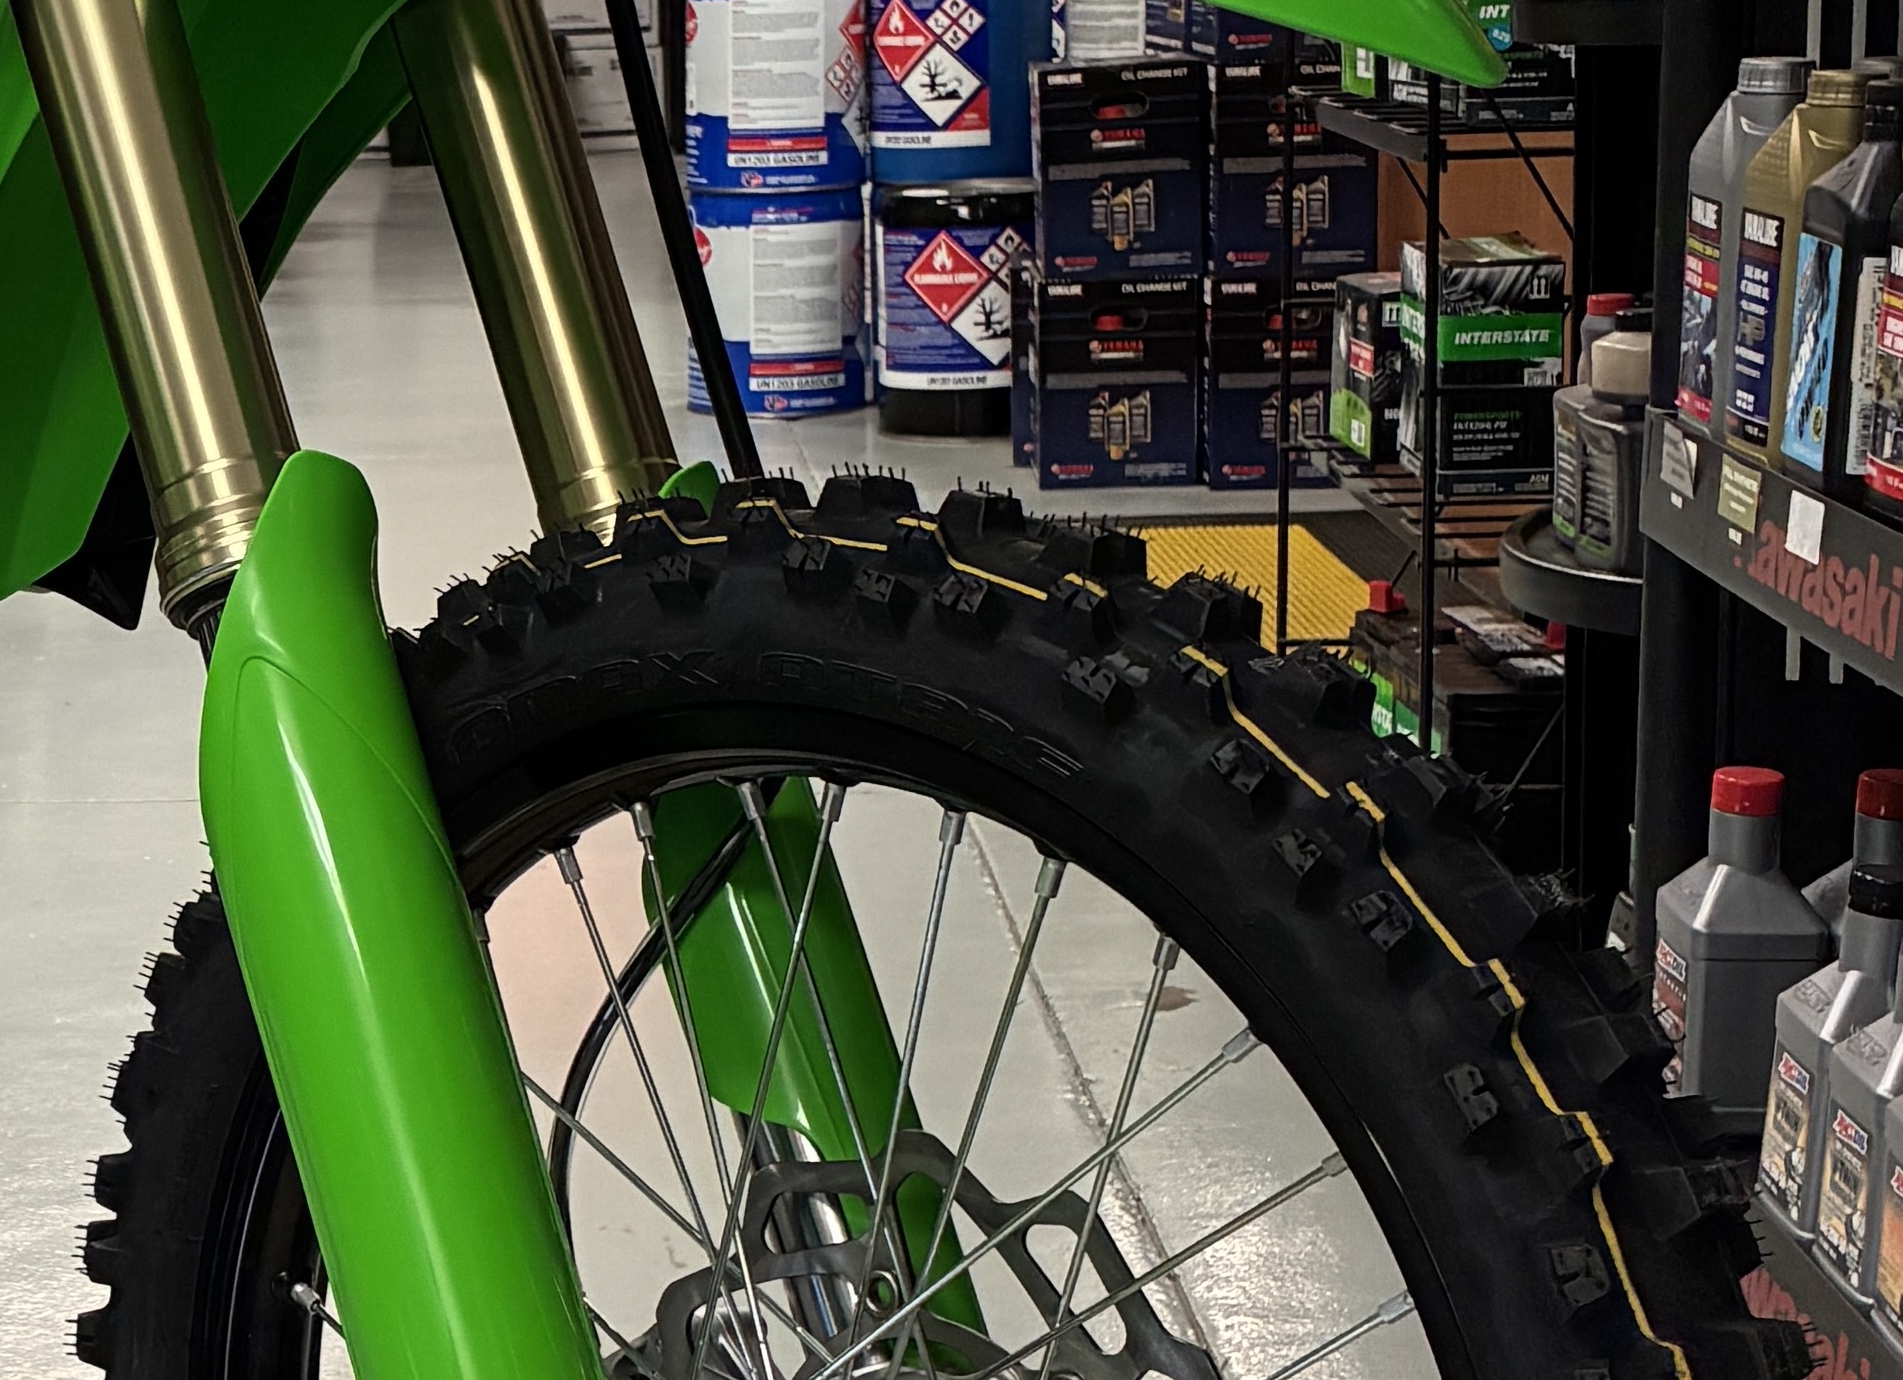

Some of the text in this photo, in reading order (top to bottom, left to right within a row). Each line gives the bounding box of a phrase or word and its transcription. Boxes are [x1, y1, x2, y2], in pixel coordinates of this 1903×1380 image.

[1479, 4, 1511, 19] INT
[1316, 63, 1341, 74] CHAN
[1313, 281, 1337, 292] CHAN
[1454, 329, 1552, 346] INTERSTATE
[1746, 519, 1902, 662] awasaki
